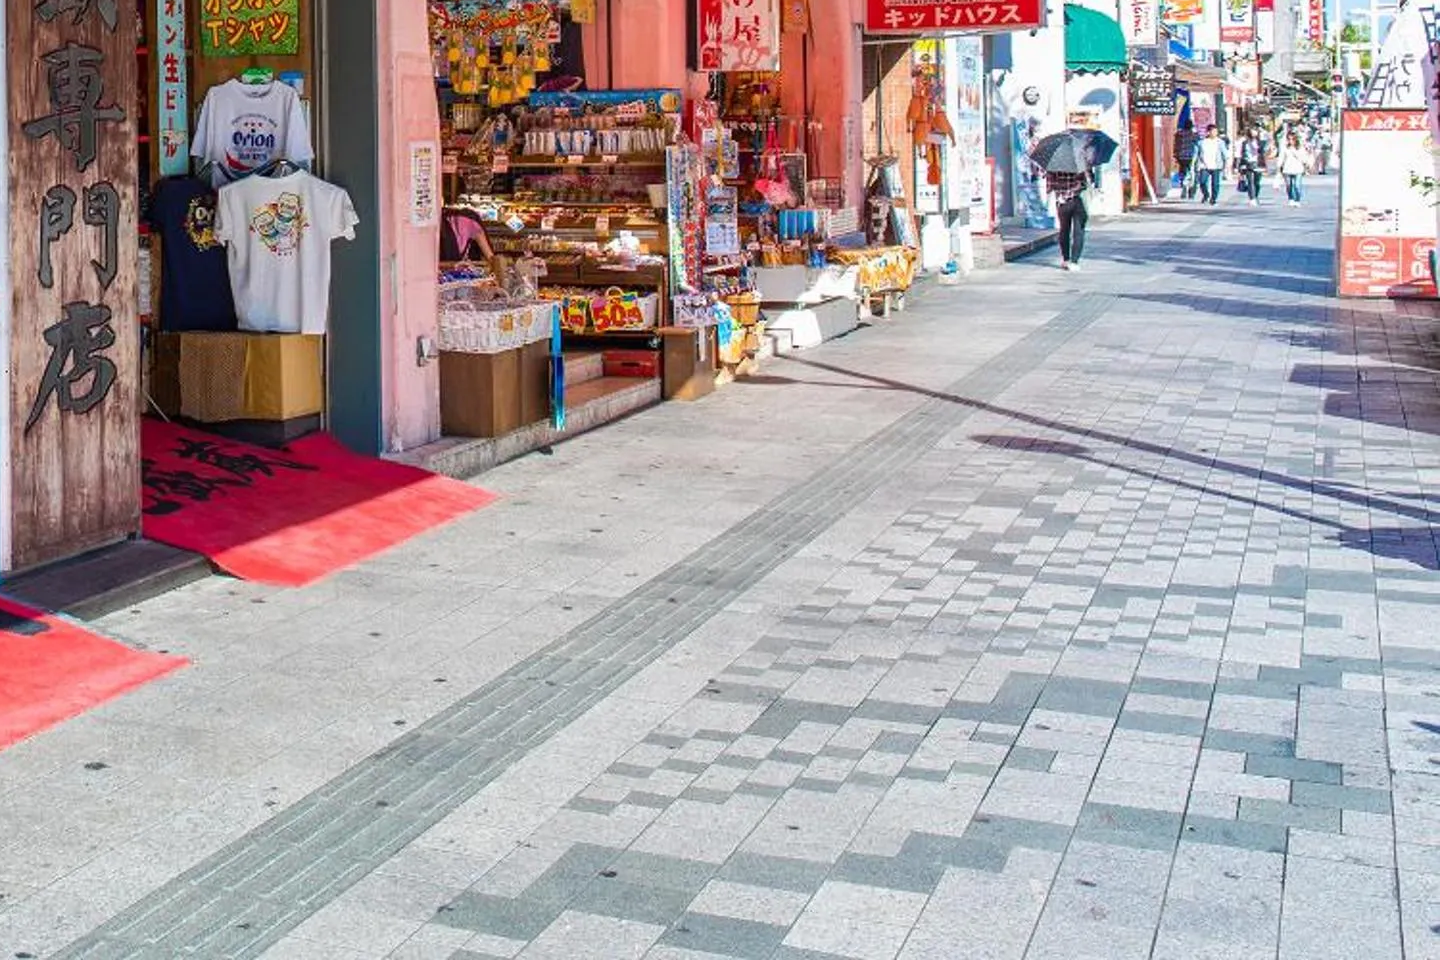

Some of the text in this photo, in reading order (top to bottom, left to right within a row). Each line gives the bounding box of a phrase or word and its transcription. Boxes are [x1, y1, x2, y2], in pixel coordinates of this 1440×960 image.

[883, 4, 1022, 28] キッドハウス
[206, 11, 291, 48] Tシャツ
[232, 128, 276, 149] Orion
